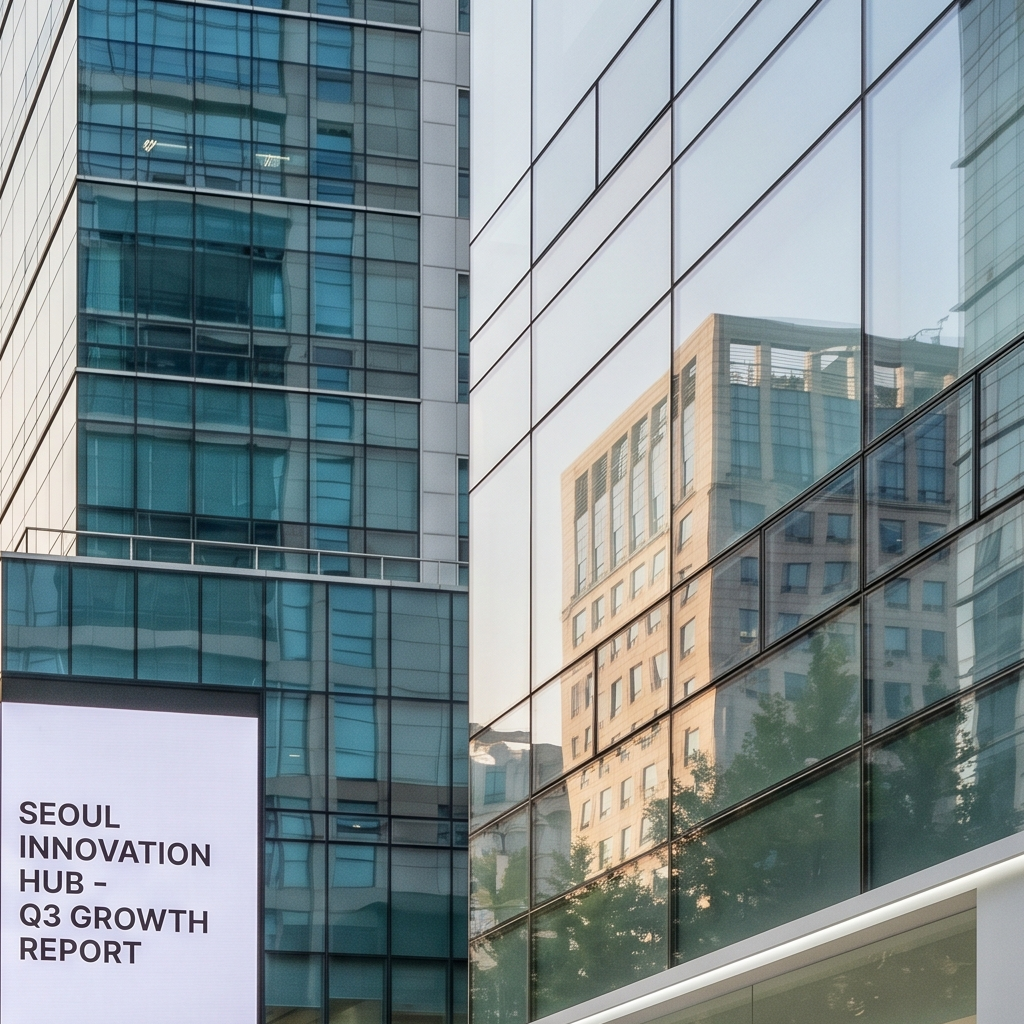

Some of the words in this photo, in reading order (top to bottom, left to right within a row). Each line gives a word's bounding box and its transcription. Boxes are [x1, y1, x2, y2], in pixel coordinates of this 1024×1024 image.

[19, 800, 121, 829] SEOUL
[20, 834, 211, 867] INNOVATION
[20, 868, 84, 895] HUB
[19, 902, 61, 929] Q3
[70, 904, 208, 934] GROWTH
[20, 936, 142, 965] REPORT
